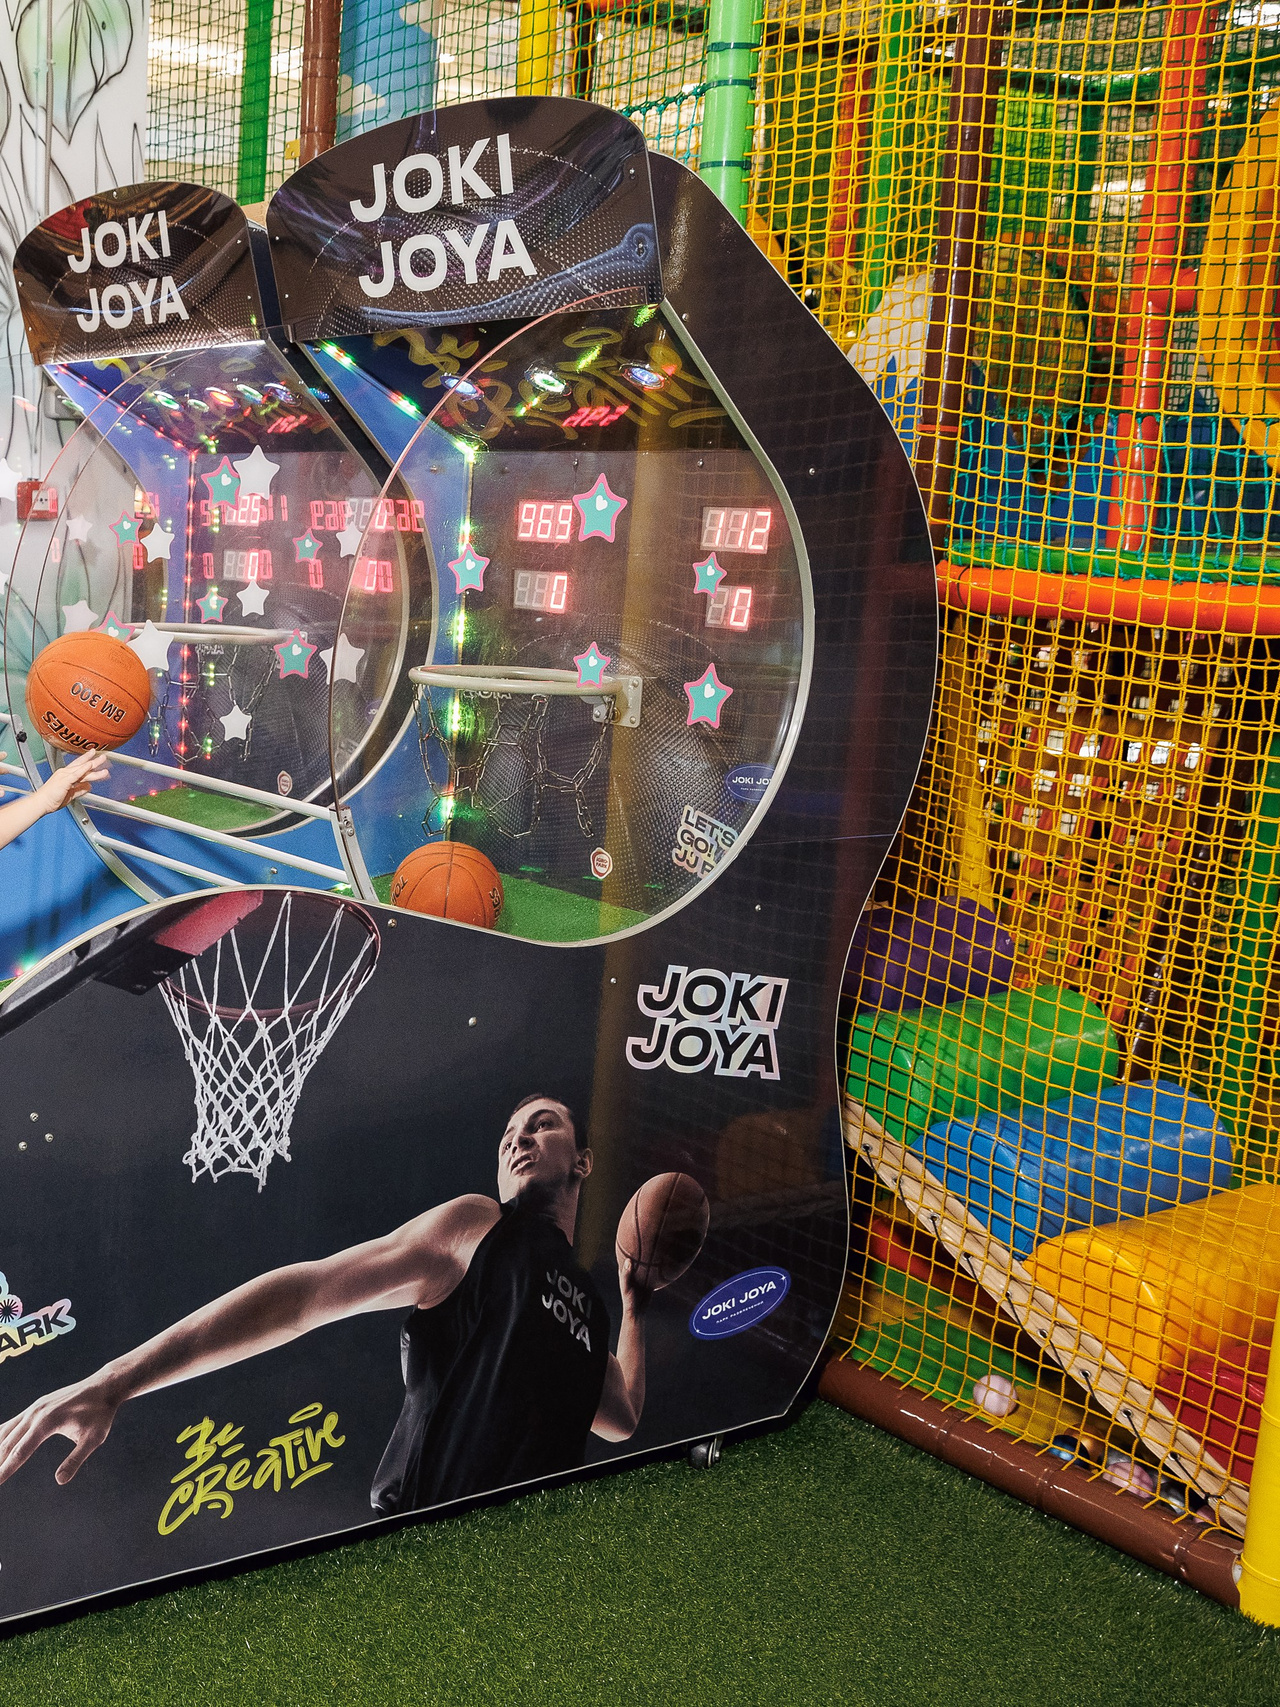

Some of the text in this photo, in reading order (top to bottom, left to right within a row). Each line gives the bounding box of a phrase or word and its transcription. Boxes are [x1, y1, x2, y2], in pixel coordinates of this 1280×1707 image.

[349, 133, 514, 223] JOKI
[67, 210, 171, 273] JOKI
[358, 219, 537, 298] JOYA
[76, 276, 189, 333] JOYA
[518, 503, 573, 540] 969
[714, 510, 772, 550] 112
[70, 681, 127, 724] BM 300
[731, 776, 754, 785] JOKI
[680, 828, 714, 858] GO!
[684, 809, 737, 848] LET'S
[641, 970, 785, 1025] JOKI
[629, 1022, 776, 1075] JOYA
[545, 1268, 593, 1320] JOKI
[701, 1280, 777, 1320] JOKI JOYA
[541, 1291, 592, 1353] JOYA
